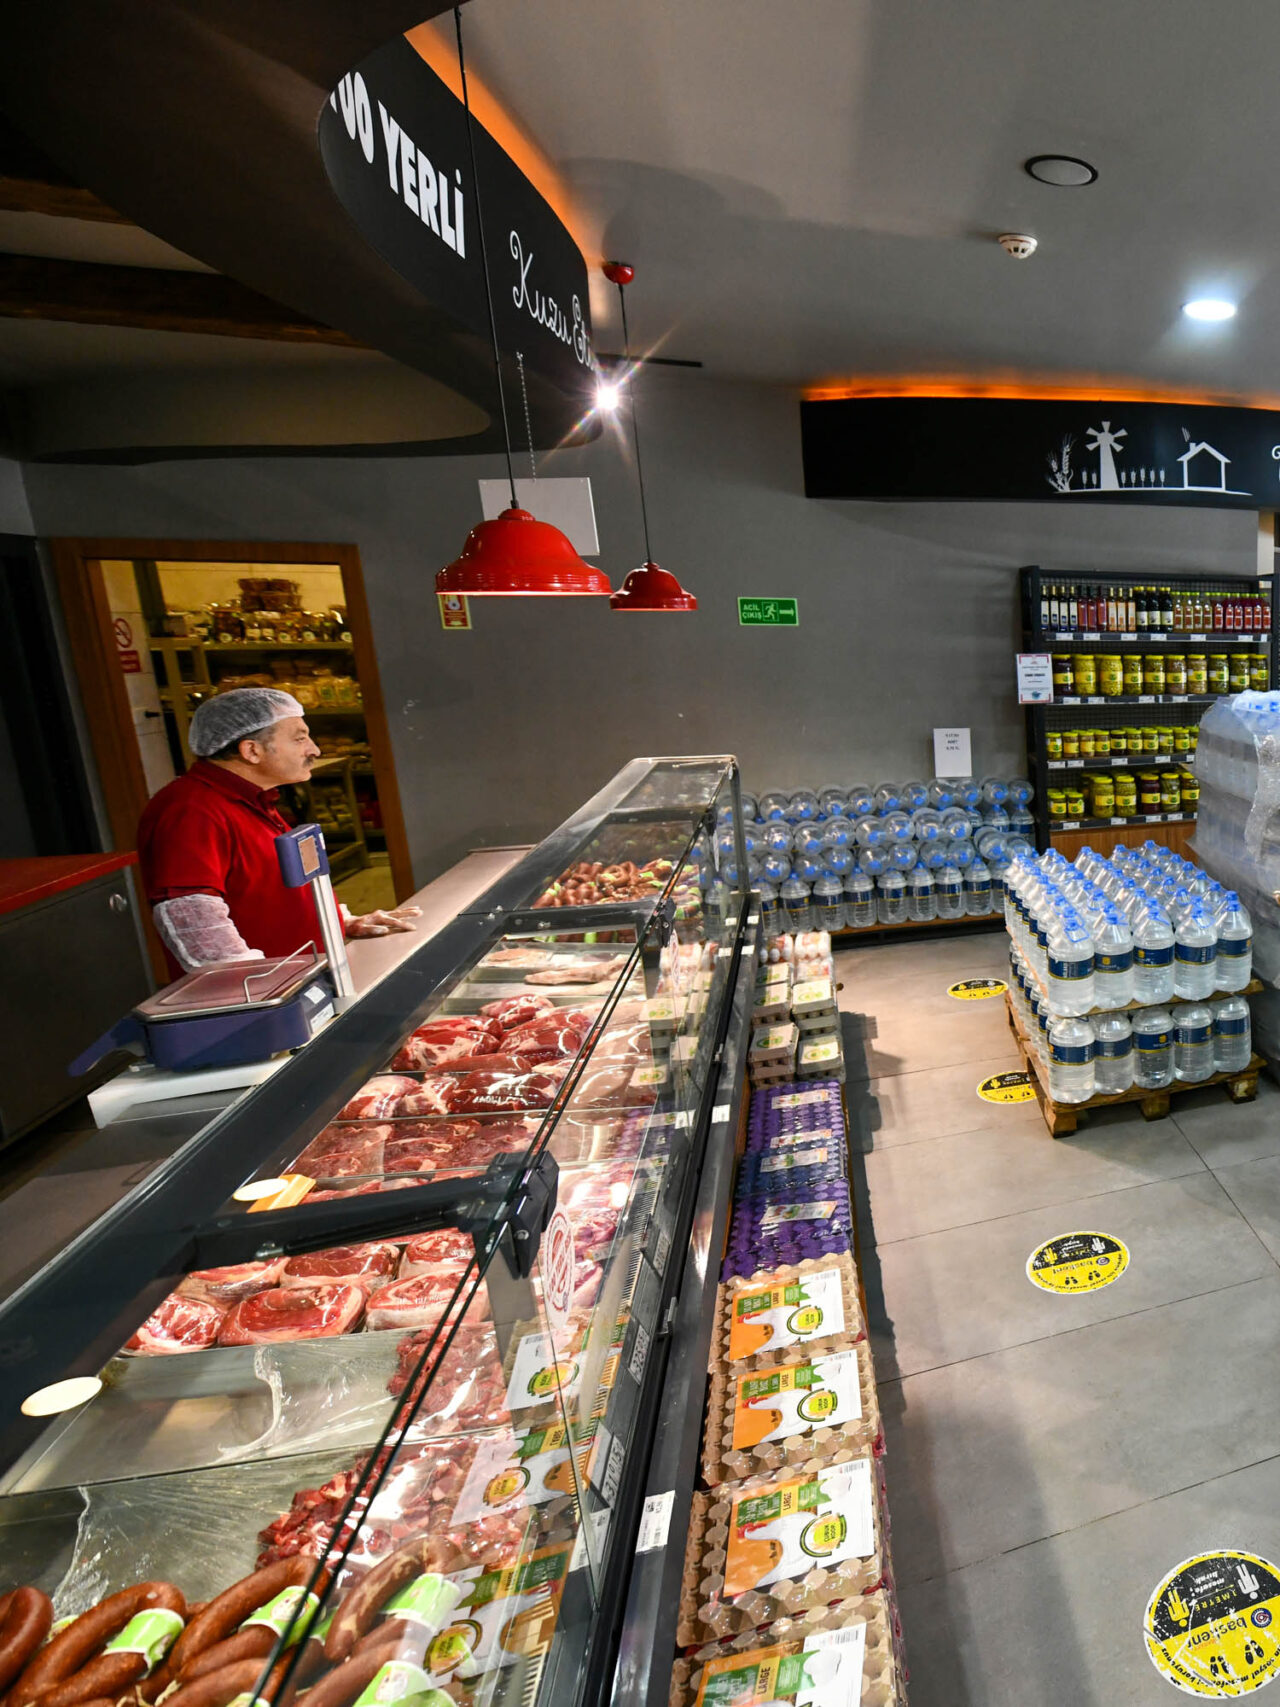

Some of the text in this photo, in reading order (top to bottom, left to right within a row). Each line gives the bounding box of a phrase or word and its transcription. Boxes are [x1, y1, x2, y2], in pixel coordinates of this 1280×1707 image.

[510, 230, 572, 345] Kuzu
[783, 1492, 792, 1511] LARGE
[757, 1666, 771, 1695] LARGE
